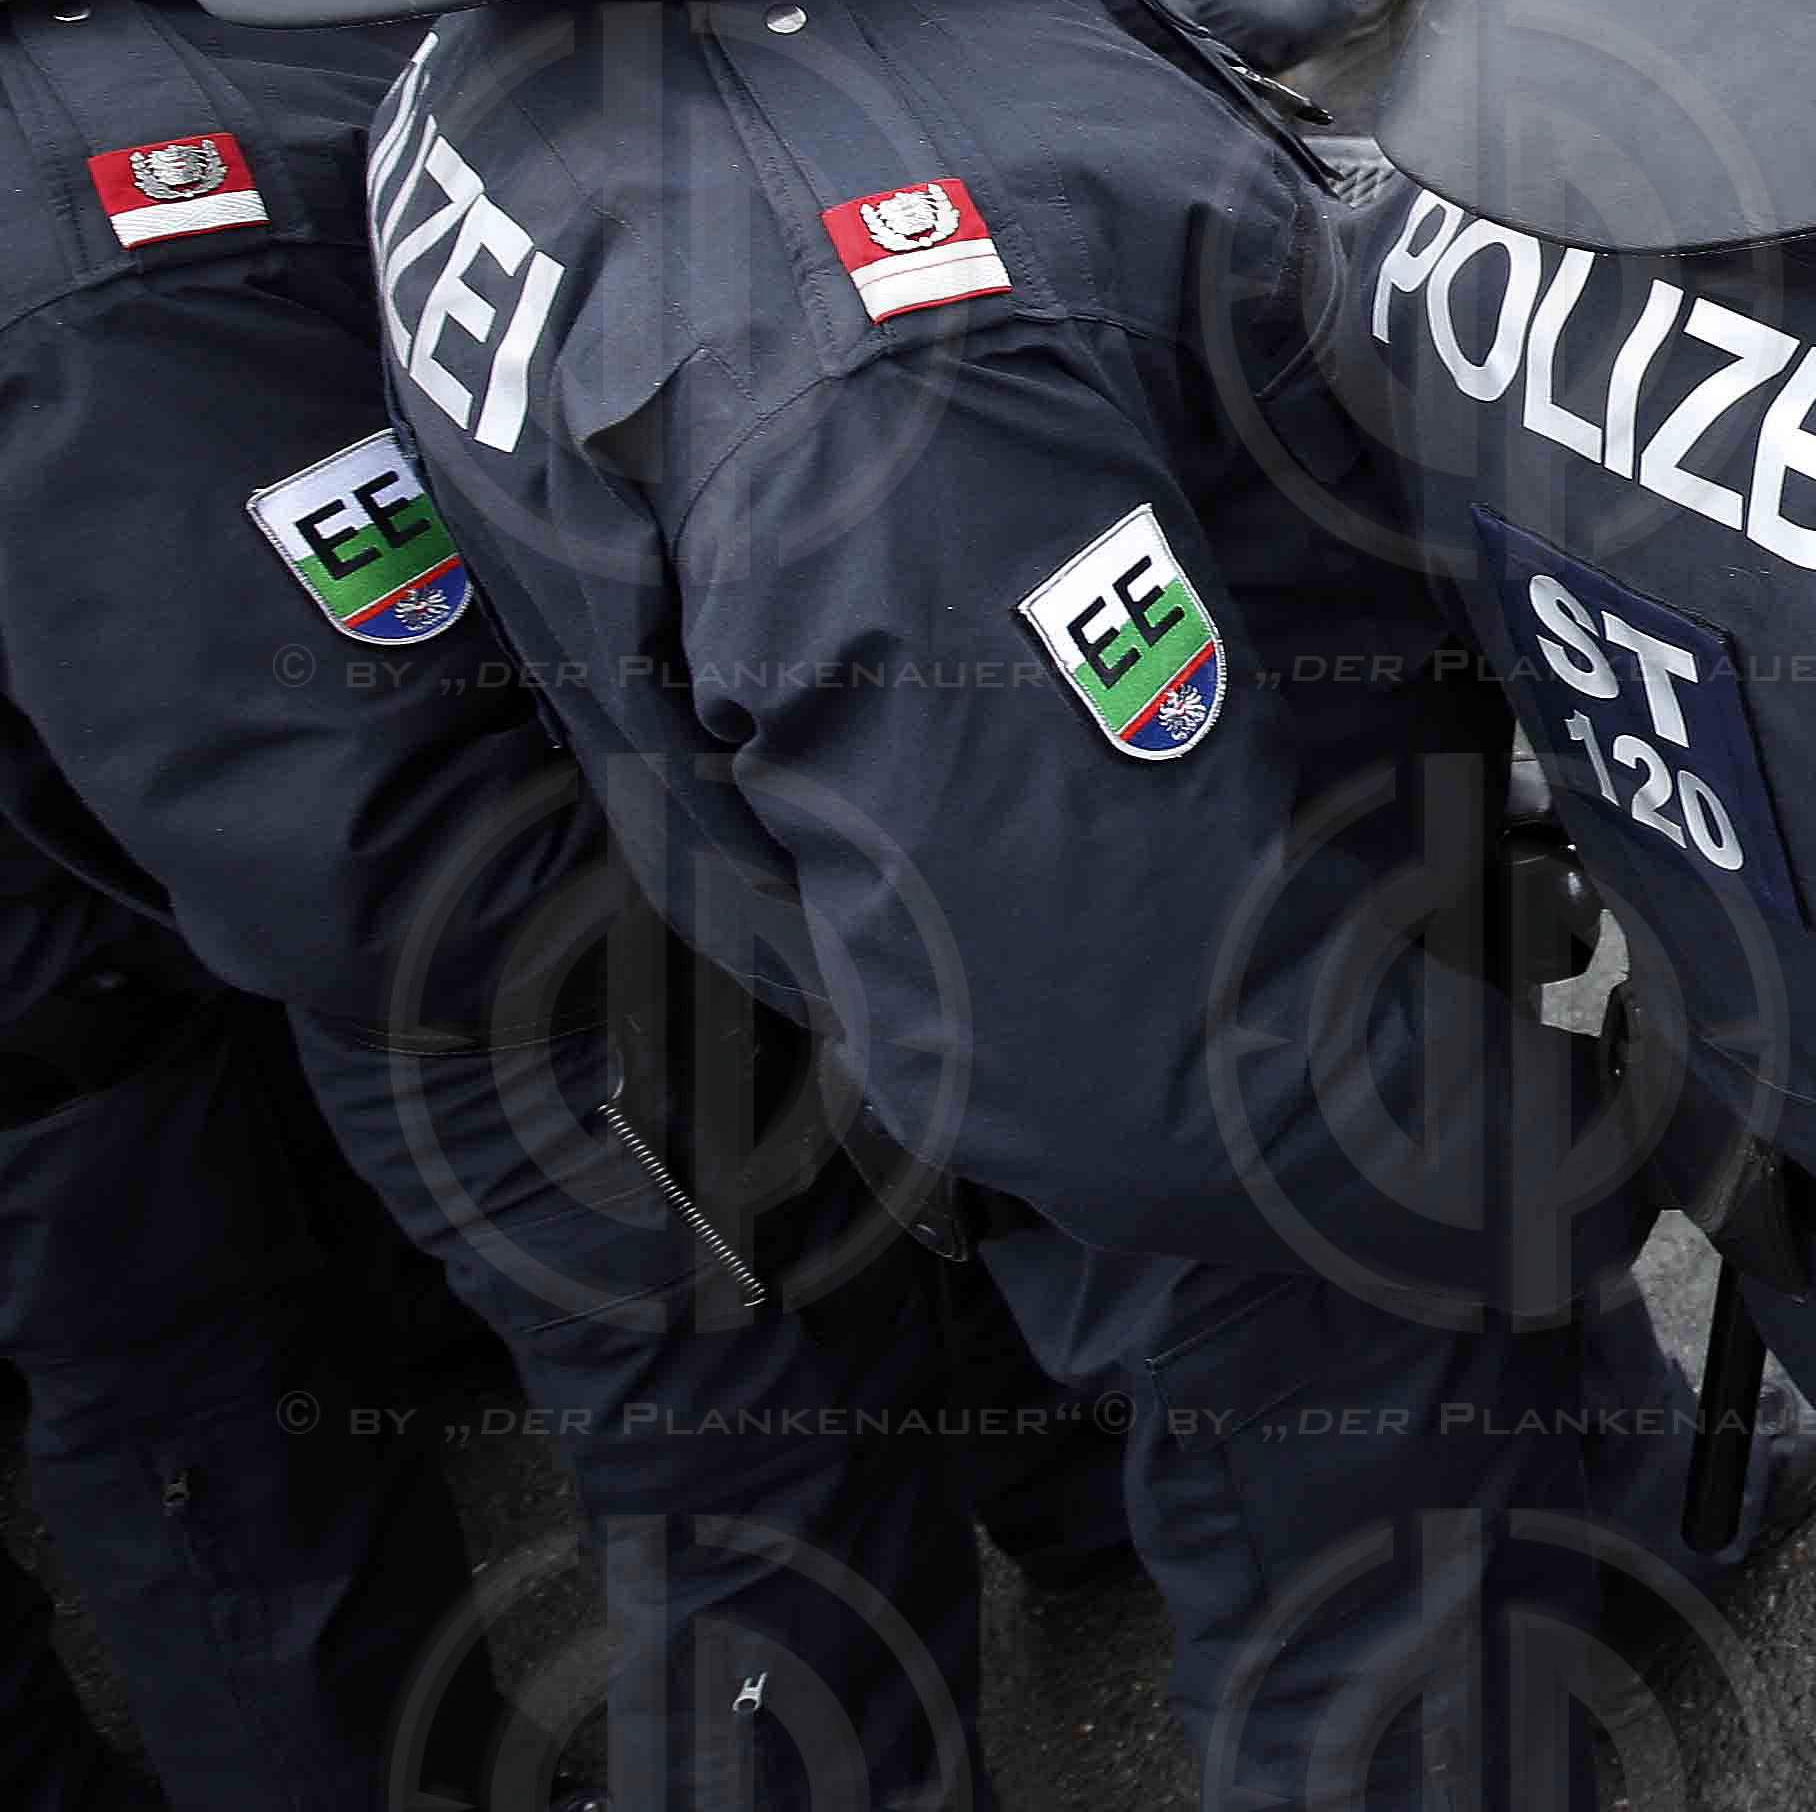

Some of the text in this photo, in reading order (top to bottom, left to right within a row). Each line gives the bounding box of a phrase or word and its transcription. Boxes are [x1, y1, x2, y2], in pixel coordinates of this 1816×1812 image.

[295, 470, 432, 581] EE
[1067, 554, 1186, 689] EE
[1530, 574, 1699, 749] ST
[1567, 712, 1744, 872] 120
